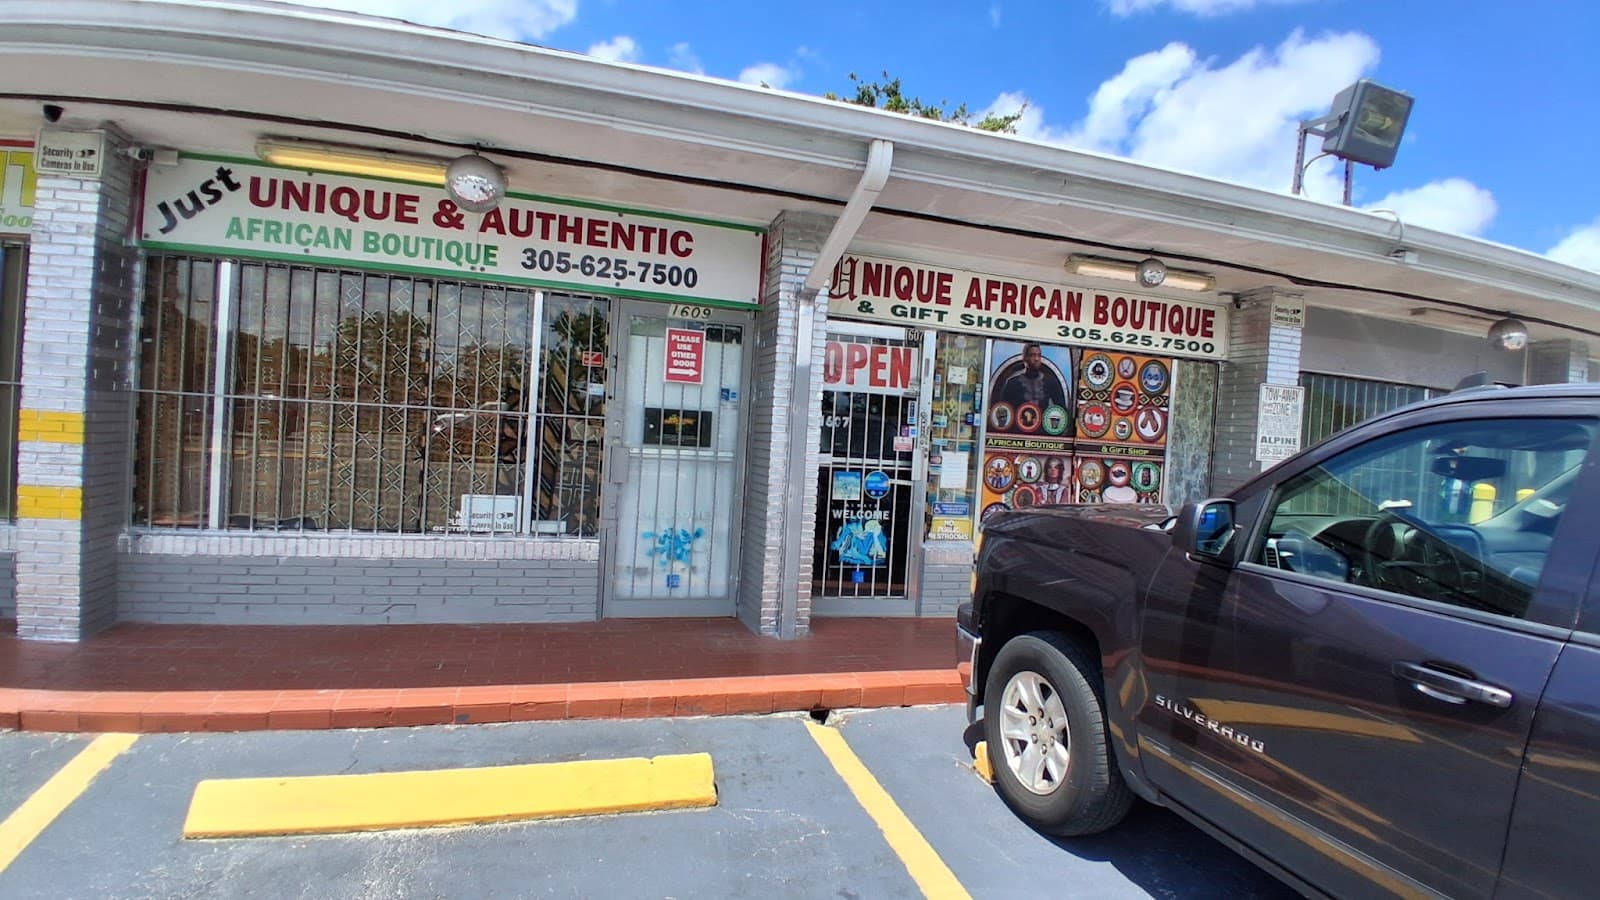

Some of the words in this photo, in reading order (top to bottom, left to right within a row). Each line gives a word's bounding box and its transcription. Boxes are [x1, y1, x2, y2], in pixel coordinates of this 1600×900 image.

[42, 145, 73, 159] Security
[41, 158, 72, 170] Cameras
[74, 160, 81, 171] In
[82, 161, 95, 171] Use
[157, 166, 241, 234] Just
[249, 176, 419, 225] UNIQUE
[432, 199, 465, 230] &
[479, 207, 694, 258] AUTHENTIC
[225, 217, 352, 250] AFRICAN
[363, 230, 498, 267] BOUTIQUE
[521, 247, 698, 289] 305-625-7500
[828, 255, 953, 306] UNIQUE
[964, 277, 1083, 322] AFRICAN
[1093, 294, 1216, 338] BOUTIQUE
[672, 305, 711, 319] 1609
[857, 300, 875, 314] &
[890, 305, 949, 322] GIFT
[960, 313, 1027, 331] SHOP
[1057, 325, 1215, 353] 305.625.7500
[671, 334, 700, 344] PLEASE
[677, 343, 692, 351] USE
[671, 351, 697, 360] OTHER
[673, 359, 695, 368] DOOR
[824, 341, 912, 389] OPEN
[1265, 387, 1300, 402] TOW-AWAY
[1272, 402, 1290, 416] ZONE
[987, 438, 1022, 447] AFRICAN
[1025, 440, 1064, 449] BOUTIQUE
[1260, 436, 1297, 446] ALPINE
[1108, 446, 1126, 454] GIFT
[1128, 447, 1149, 455] SHOP
[832, 509, 890, 520] WELCOME
[1155, 694, 1265, 753] SILVERADO
